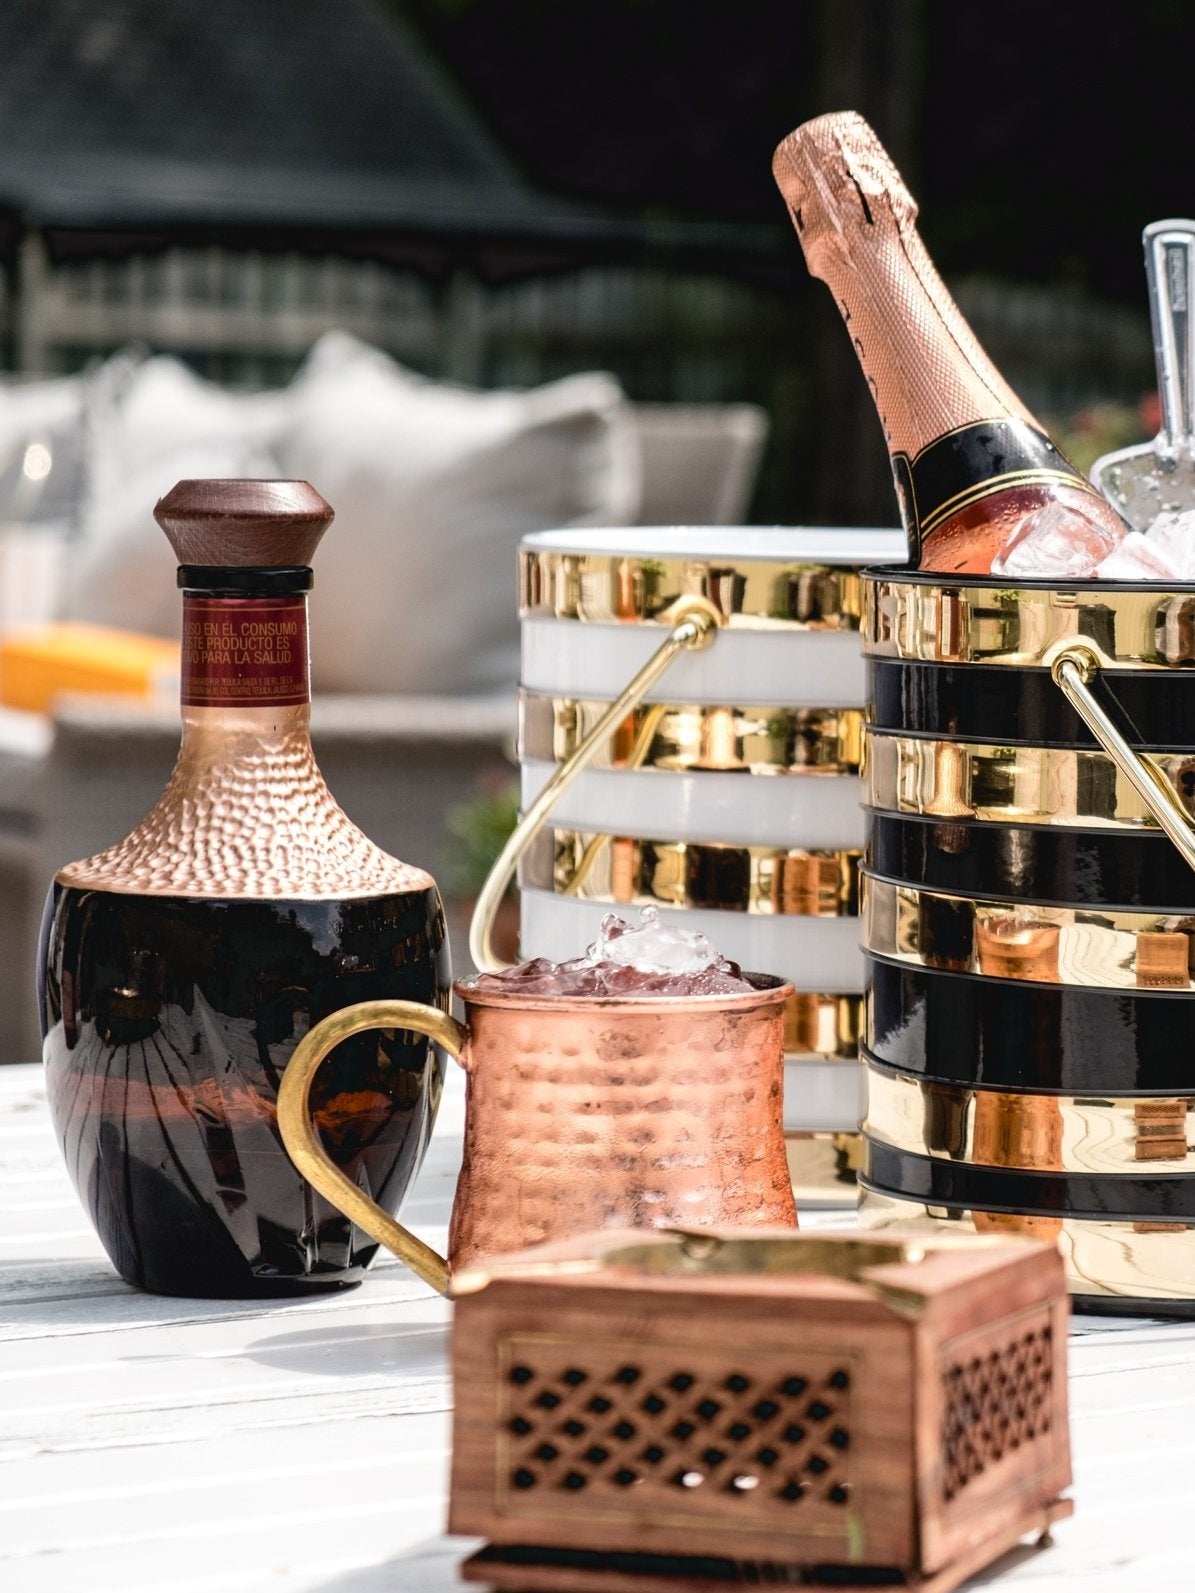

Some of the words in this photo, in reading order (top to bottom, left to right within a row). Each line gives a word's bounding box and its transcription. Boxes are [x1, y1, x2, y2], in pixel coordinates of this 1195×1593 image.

[204, 622, 218, 636] EN
[241, 622, 297, 636] CONSUMO
[207, 636, 273, 650] PRODUCTO
[276, 636, 290, 649] ES
[201, 651, 231, 664] PARA
[234, 651, 250, 664] LA
[254, 651, 291, 664] SALUD
